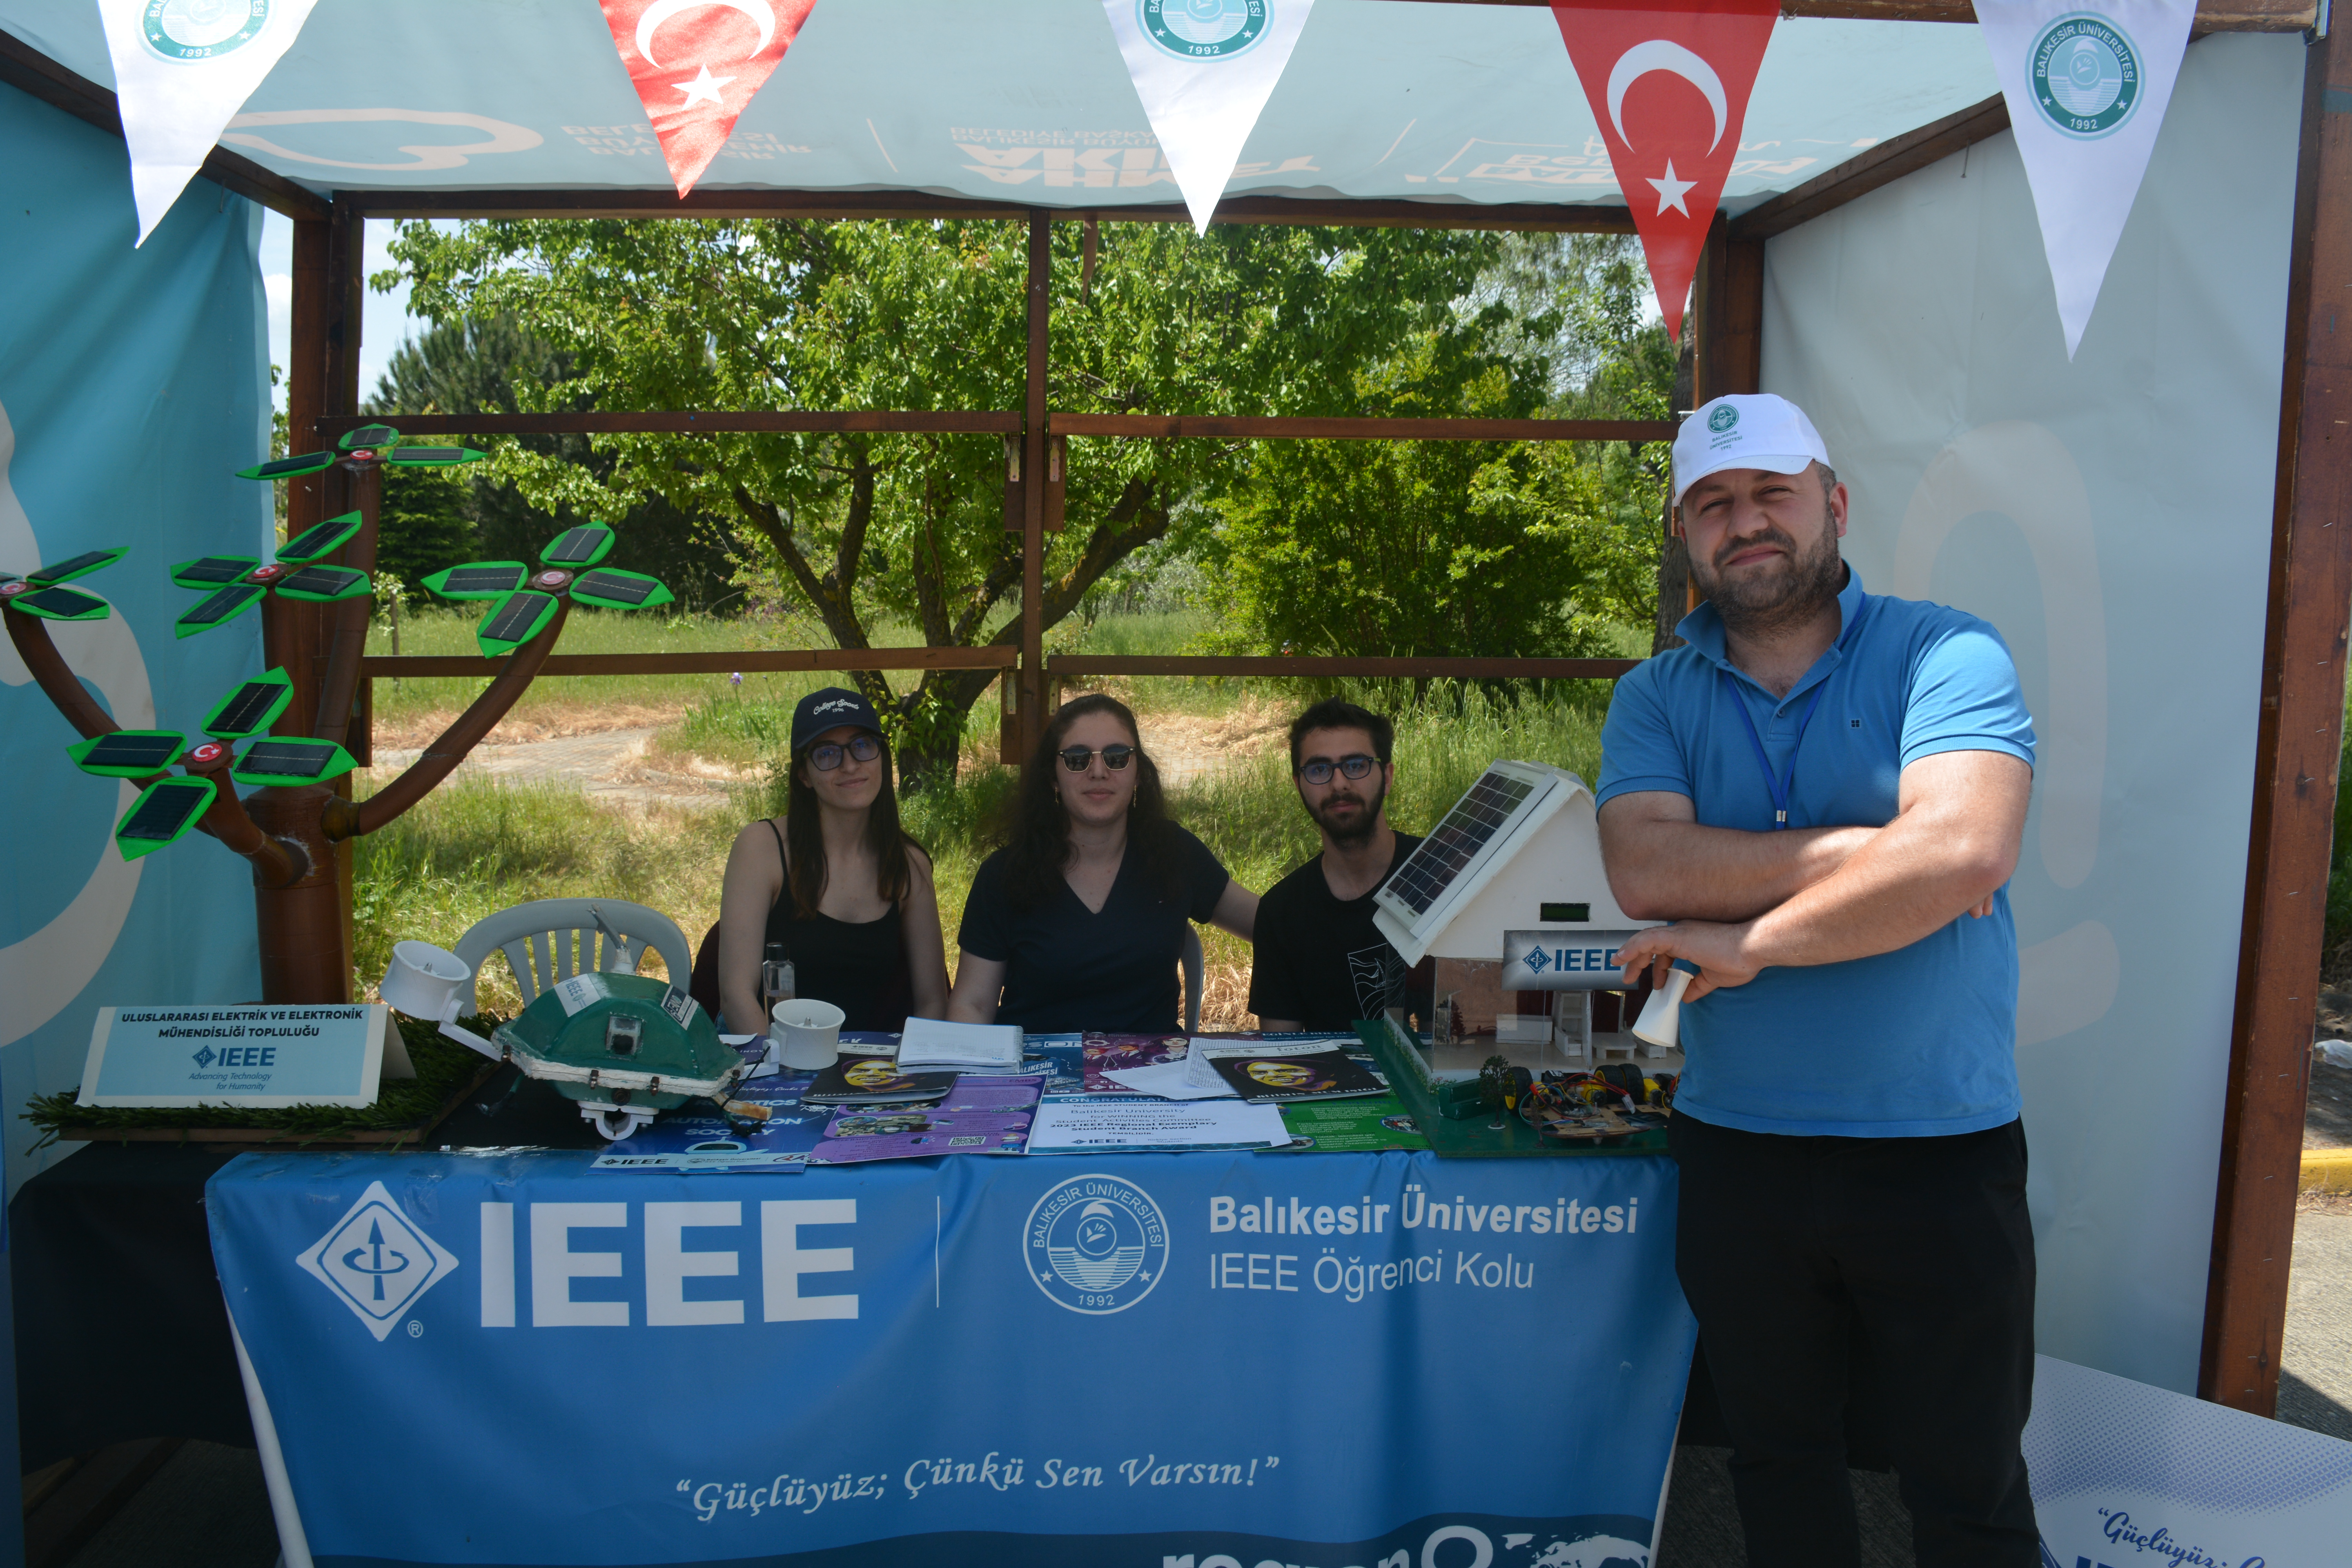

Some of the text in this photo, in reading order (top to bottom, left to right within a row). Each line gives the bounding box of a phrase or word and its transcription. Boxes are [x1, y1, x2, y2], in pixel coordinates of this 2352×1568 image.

[179, 47, 212, 58] 1992
[1188, 45, 1220, 54] 1992
[2036, 22, 2135, 82] BALIKESİR ÜNİVERSİTESİ
[2070, 118, 2098, 130] 1992
[1709, 436, 1742, 450] ÜNİVERSİTESİ
[1712, 431, 1737, 442] BALIKESİR
[814, 699, 859, 715] College Sports
[566, 980, 583, 996] IEEE
[122, 1007, 363, 1022] ULUSLARARASI ELEKTRİK VE ELEKTRONİK
[158, 1025, 319, 1038] MÜHENDİSLİĞİ TOPLULUĞU
[218, 1047, 276, 1067] IEEE
[1018, 1061, 1053, 1073] ALIKESİR
[189, 1072, 272, 1082] Advancing Technology
[229, 1082, 265, 1091] Humanity
[1033, 1183, 1164, 1247] BALIKESİR ÜNİVERSİTESİ
[1210, 1184, 1637, 1234] Balıkesir Üniversitesi
[481, 1199, 859, 1327] IEEE
[1210, 1247, 1534, 1303] IEEE Öğrenci Kolu
[1078, 1294, 1115, 1306] 1992
[904, 1451, 1024, 1499] Çünkü
[1036, 1459, 1103, 1488] Sen
